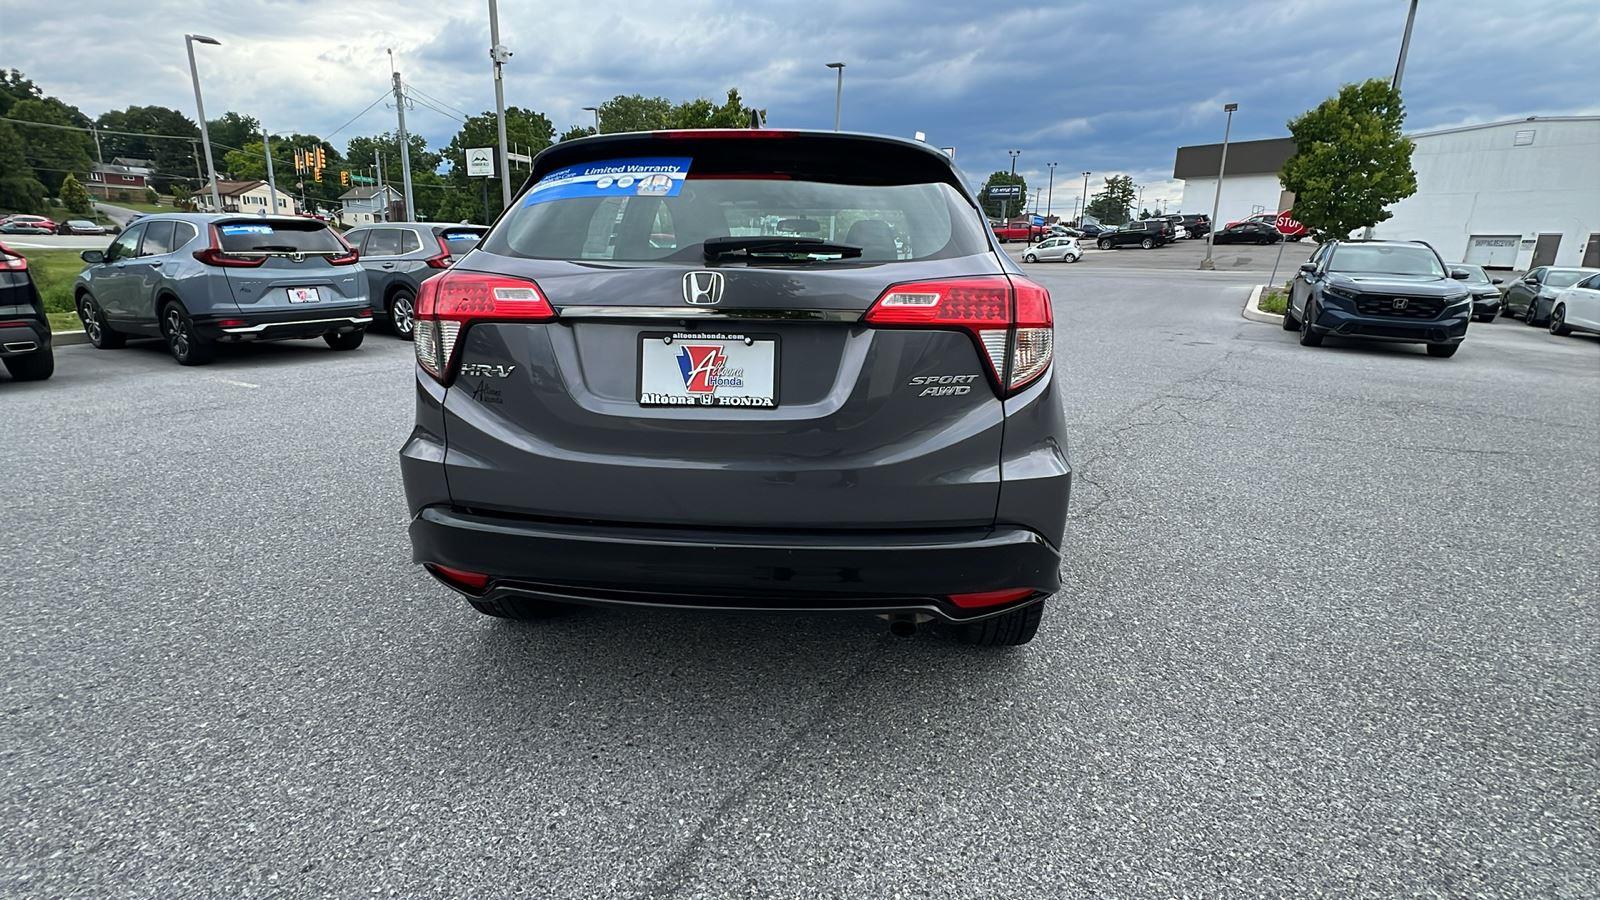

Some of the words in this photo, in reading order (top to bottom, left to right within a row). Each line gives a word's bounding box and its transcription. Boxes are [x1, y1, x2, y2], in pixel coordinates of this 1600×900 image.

[584, 166, 625, 176] Limited
[627, 164, 680, 173] Warranty
[673, 332, 744, 340] altoonahonda.com
[461, 363, 516, 378] HR-V
[688, 349, 743, 387] Altoona
[709, 375, 743, 387] Honda
[908, 374, 979, 386] SPORT
[918, 385, 971, 397] AWD
[640, 393, 695, 405] Altoona
[719, 396, 774, 407] HONDA
